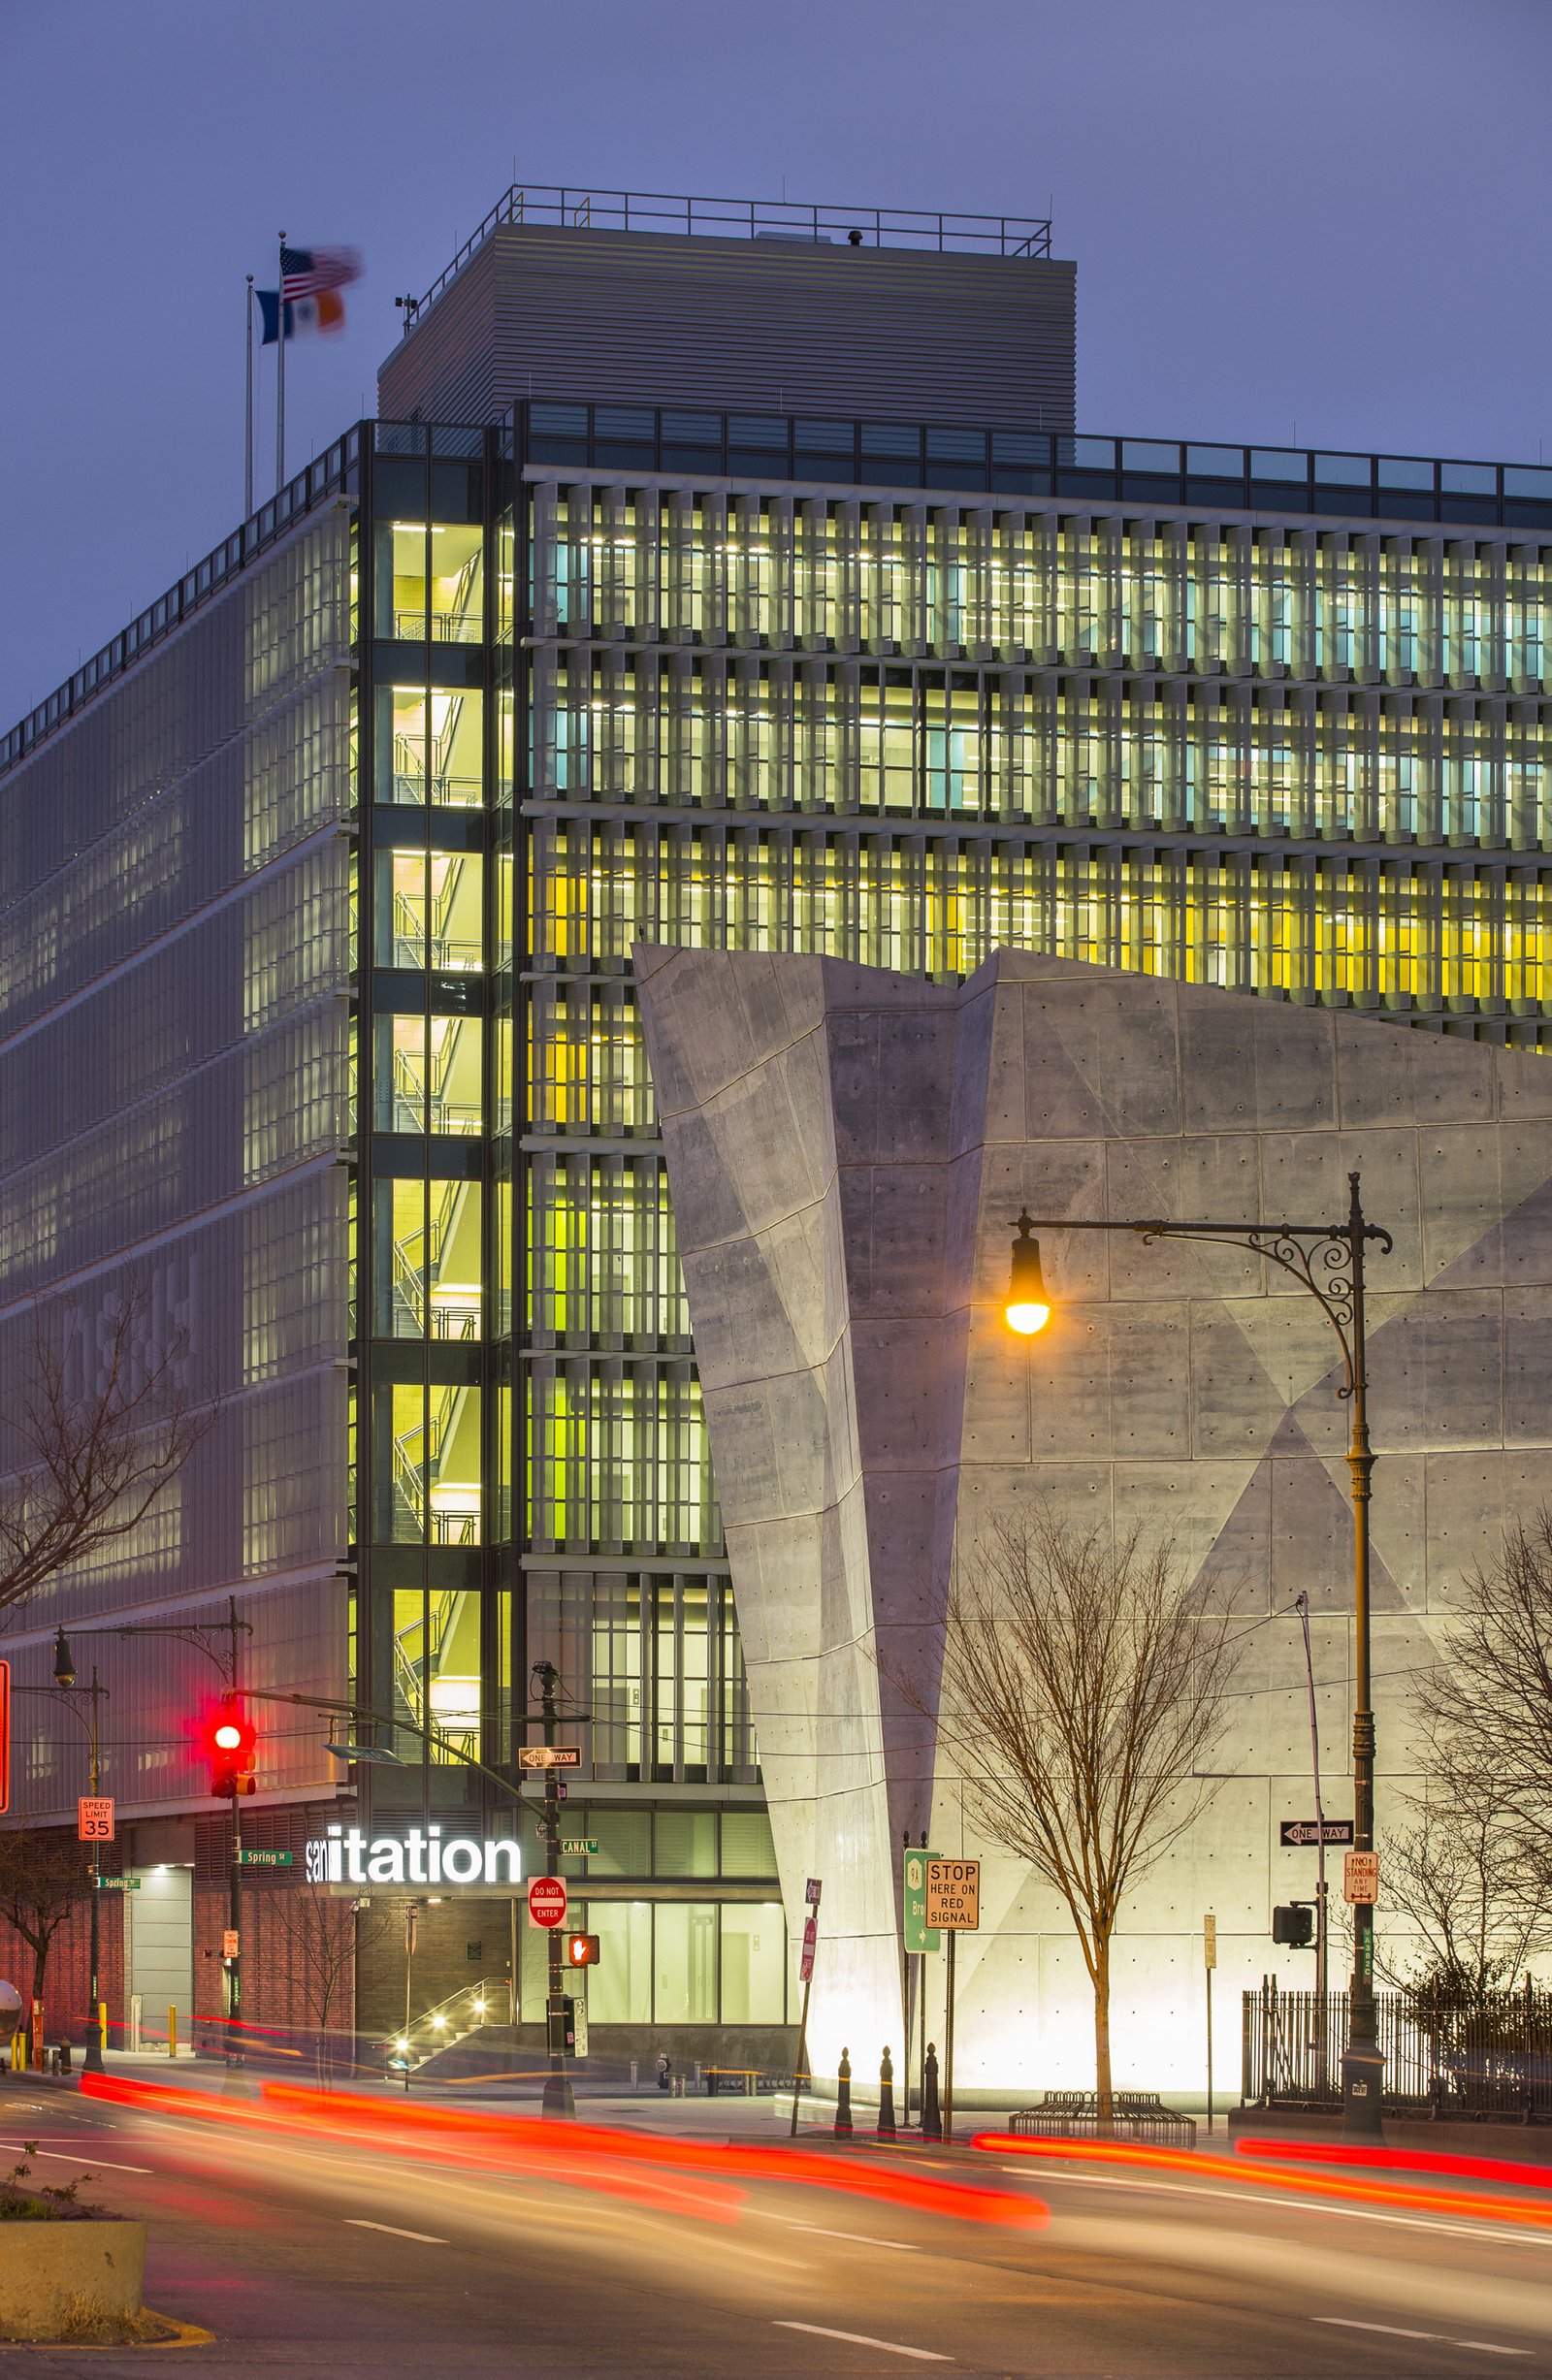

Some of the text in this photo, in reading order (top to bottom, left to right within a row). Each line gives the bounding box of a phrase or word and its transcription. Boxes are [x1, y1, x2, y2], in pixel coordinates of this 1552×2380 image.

[529, 1753, 573, 1762] ONE WAY
[84, 1820, 109, 1835] 35
[1291, 1828, 1344, 1839] ONE WAY
[562, 1841, 591, 1853] CANAL
[247, 1851, 276, 1865] Spring
[1355, 1856, 1368, 1867] NO
[911, 1867, 920, 1882] 9A
[930, 1864, 976, 1881] STOP
[1345, 1867, 1377, 1878] STANDING
[105, 1878, 128, 1889] Spring
[930, 1883, 976, 1895] HERE ON
[1353, 1884, 1369, 1893] TIME
[534, 1886, 560, 1896] DO NOT
[941, 1898, 964, 1909] RED
[536, 1909, 559, 1918] ENTER
[930, 1912, 975, 1924] SIGNAL
